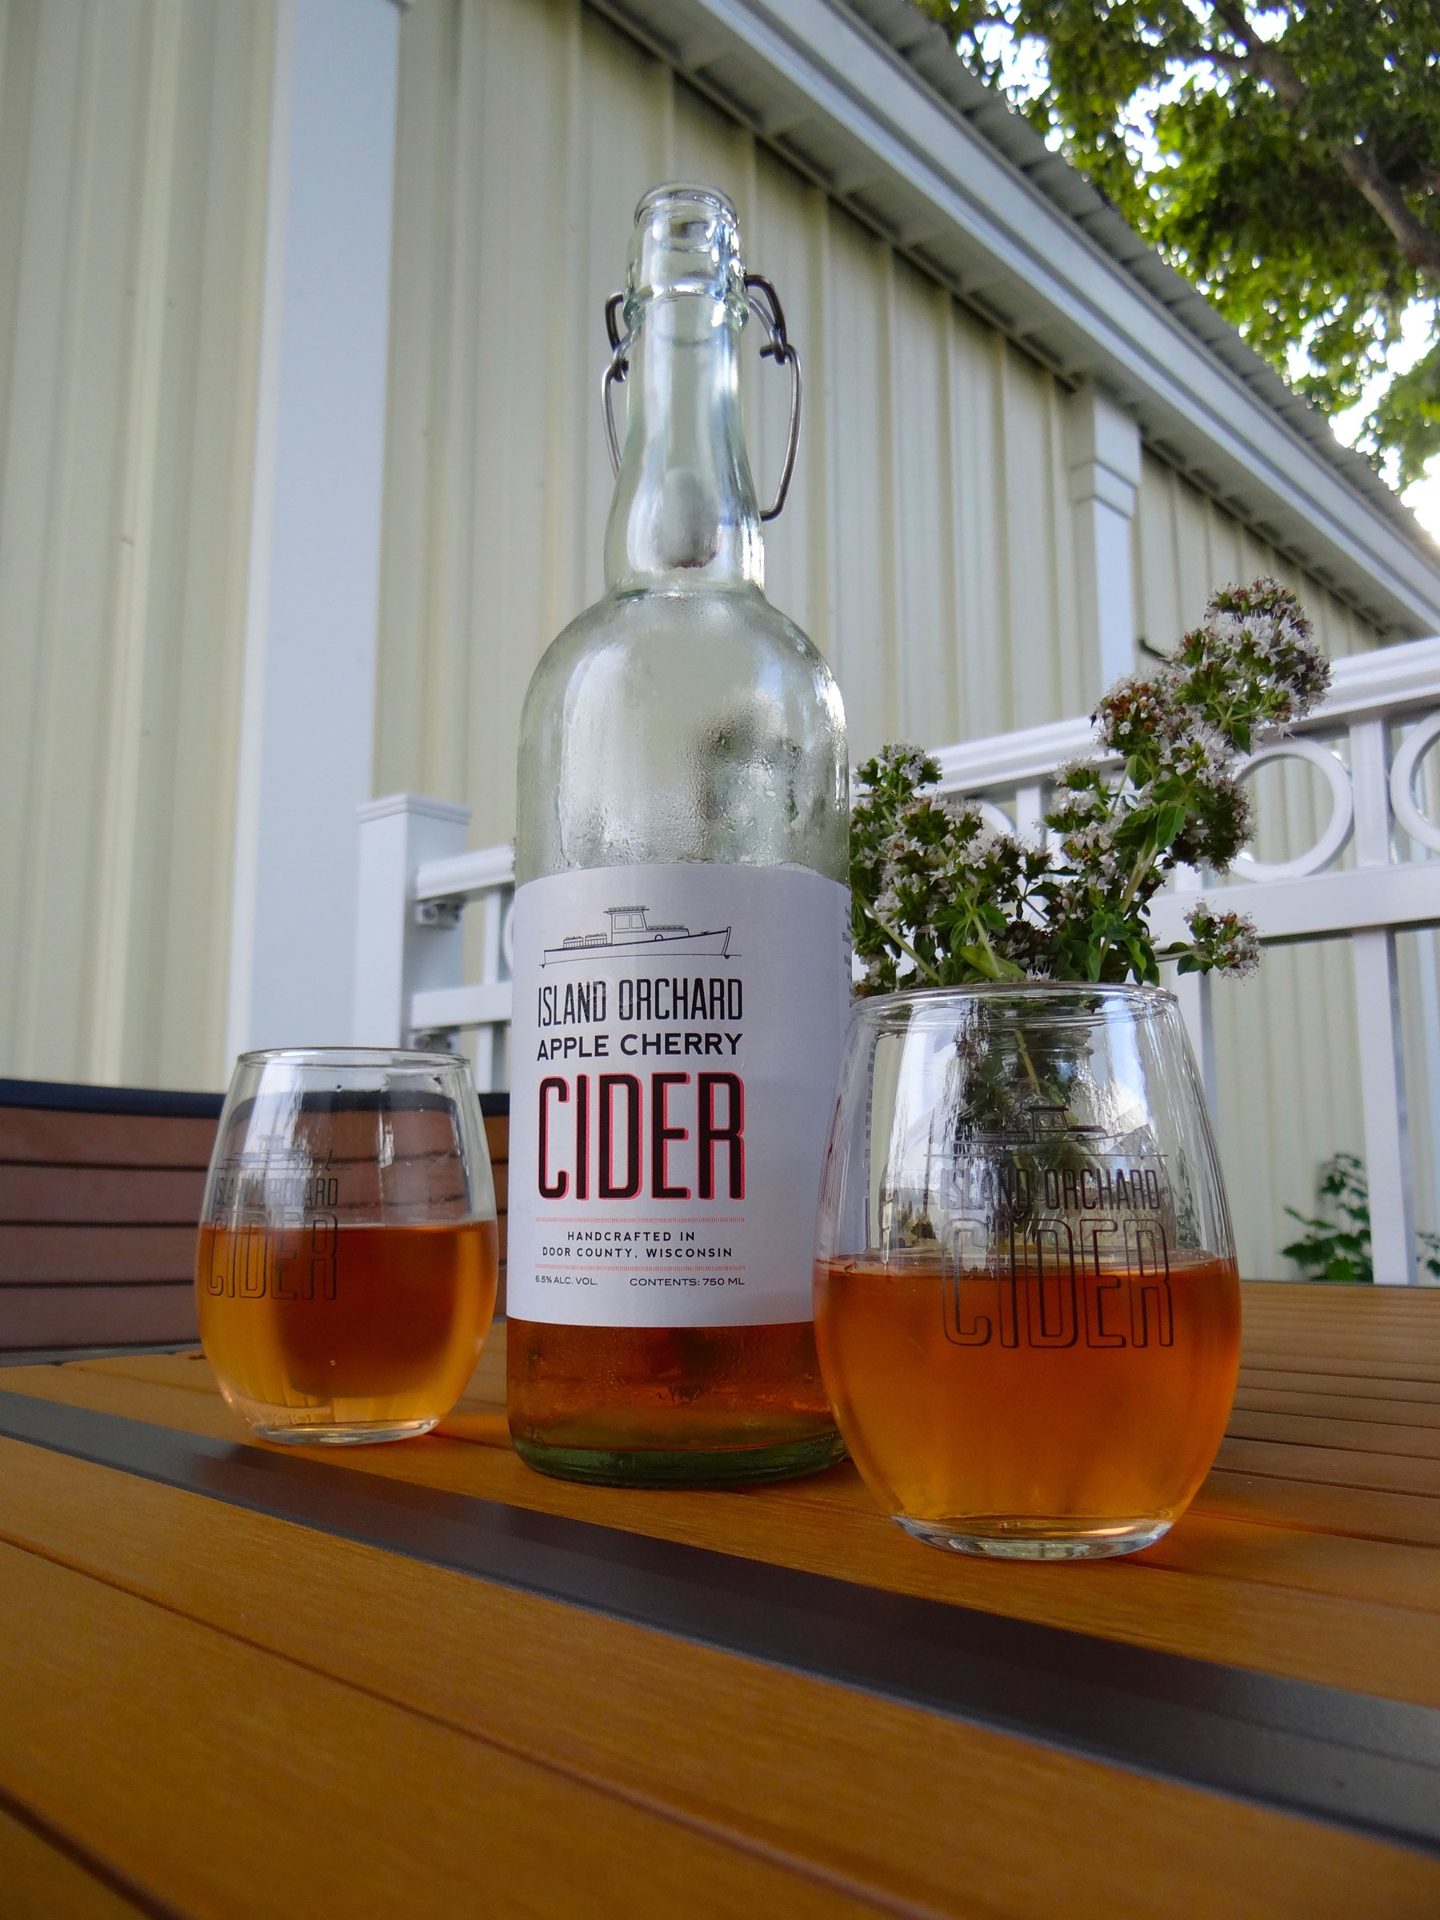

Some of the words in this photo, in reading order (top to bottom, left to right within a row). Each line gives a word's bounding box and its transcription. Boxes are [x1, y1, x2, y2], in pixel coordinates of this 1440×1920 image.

[538, 981, 607, 1028] ISLAND
[618, 977, 744, 1021] ORCHARD
[536, 1034, 610, 1062] APPLE
[620, 1033, 743, 1055] CHERRY
[537, 1071, 746, 1201] CIDER
[1043, 1167, 1163, 1211] ORCHARD
[207, 1210, 339, 1301] CIDER
[542, 1246, 572, 1257] DOOR
[576, 1247, 639, 1259] COUNTY,
[646, 1247, 733, 1258] WISCONSIN
[567, 1231, 673, 1242] HANDCRAFTED
[680, 1231, 696, 1242] IN
[629, 1277, 701, 1287] CONTENTS:
[702, 1277, 726, 1287] 750
[728, 1277, 746, 1287] ML
[941, 1217, 1174, 1349] CIDER
